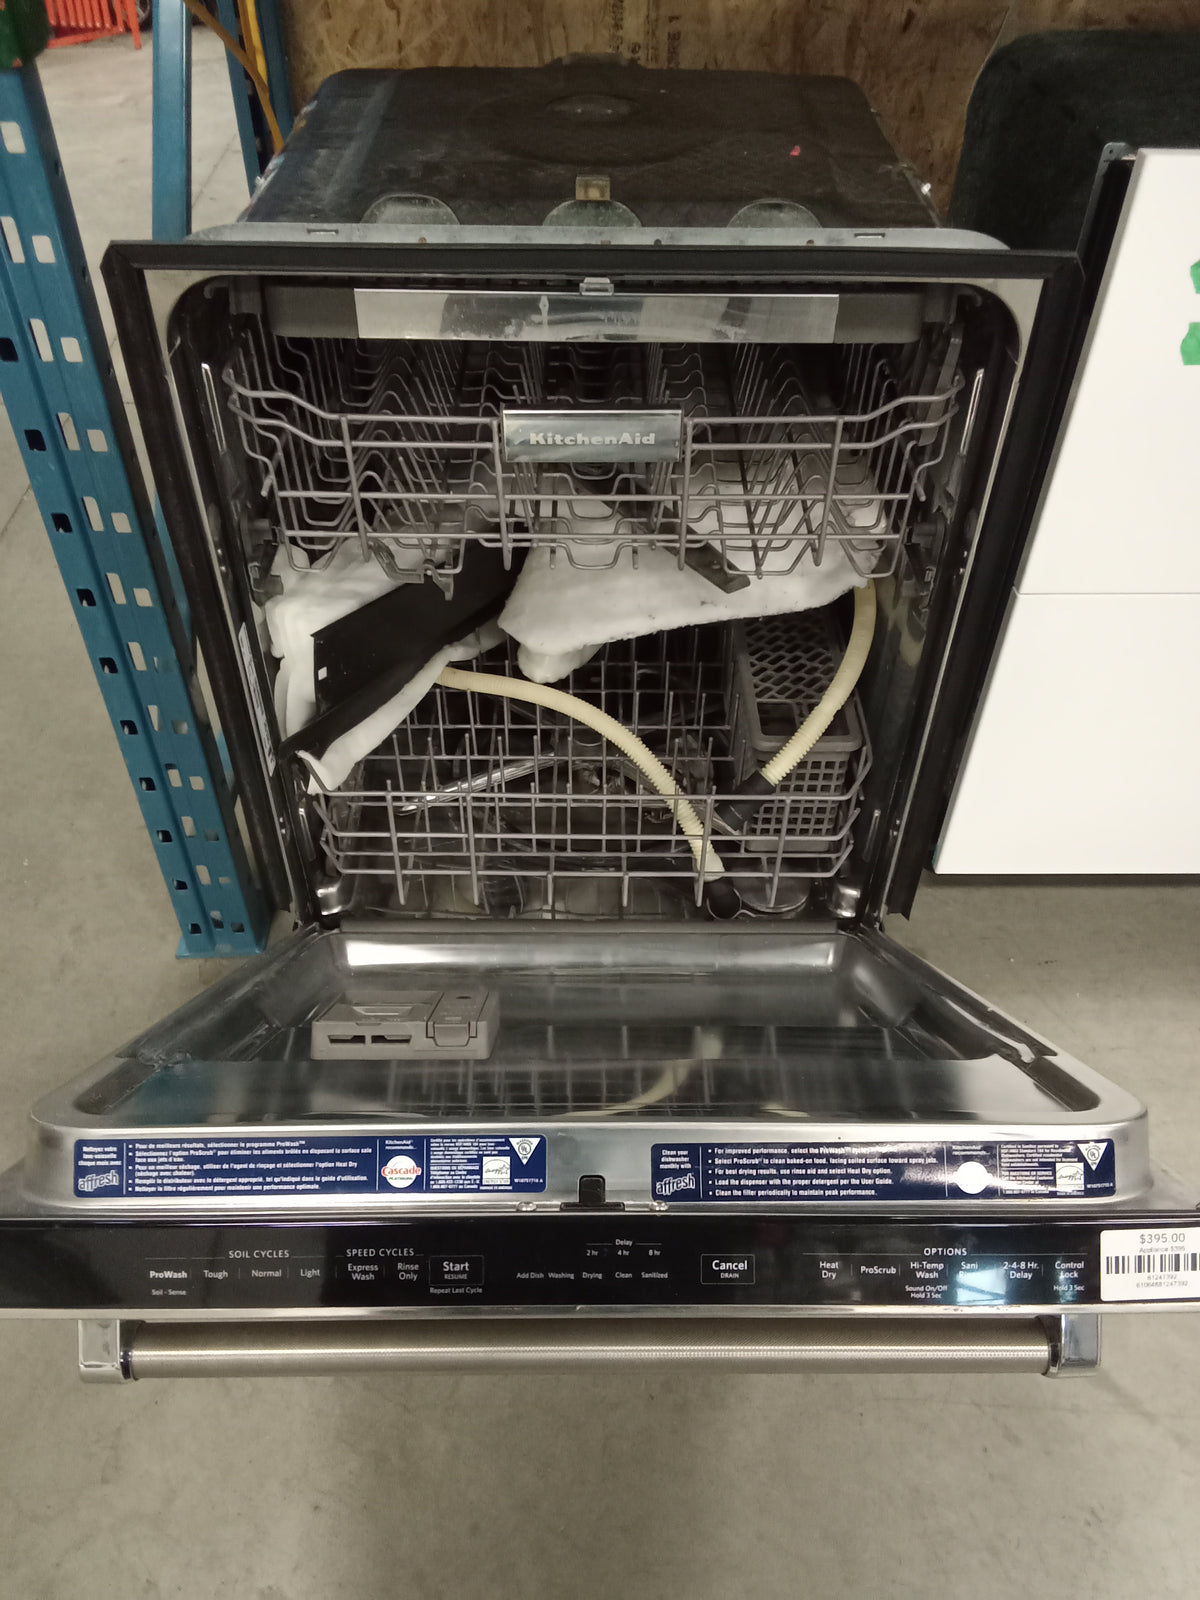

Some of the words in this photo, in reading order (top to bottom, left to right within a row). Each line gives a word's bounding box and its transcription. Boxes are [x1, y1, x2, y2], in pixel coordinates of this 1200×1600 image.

[530, 433, 655, 445] KitchenAid
[383, 1166, 421, 1176] Cascade
[78, 1170, 119, 1191] affresh
[656, 1173, 695, 1195] affresh
[1140, 1233, 1185, 1244] $395.00
[228, 1250, 250, 1258] SOIL
[379, 1248, 415, 1256] CYCLES
[924, 1248, 967, 1256] OPTIONS
[348, 1264, 378, 1272] Express
[443, 1261, 469, 1272] Start
[712, 1260, 748, 1270] Cancel
[819, 1261, 839, 1269] Heat
[910, 1262, 944, 1271] Hi-Temp
[1055, 1261, 1084, 1269] Control
[150, 1270, 187, 1279] ProWash
[252, 1269, 282, 1277] Normal
[300, 1269, 320, 1278] Light
[860, 1266, 896, 1274] ProScrub
[204, 1270, 228, 1280] Tough
[399, 1272, 418, 1282] Only
[822, 1270, 836, 1280] Dry
[1010, 1271, 1032, 1280] Delay
